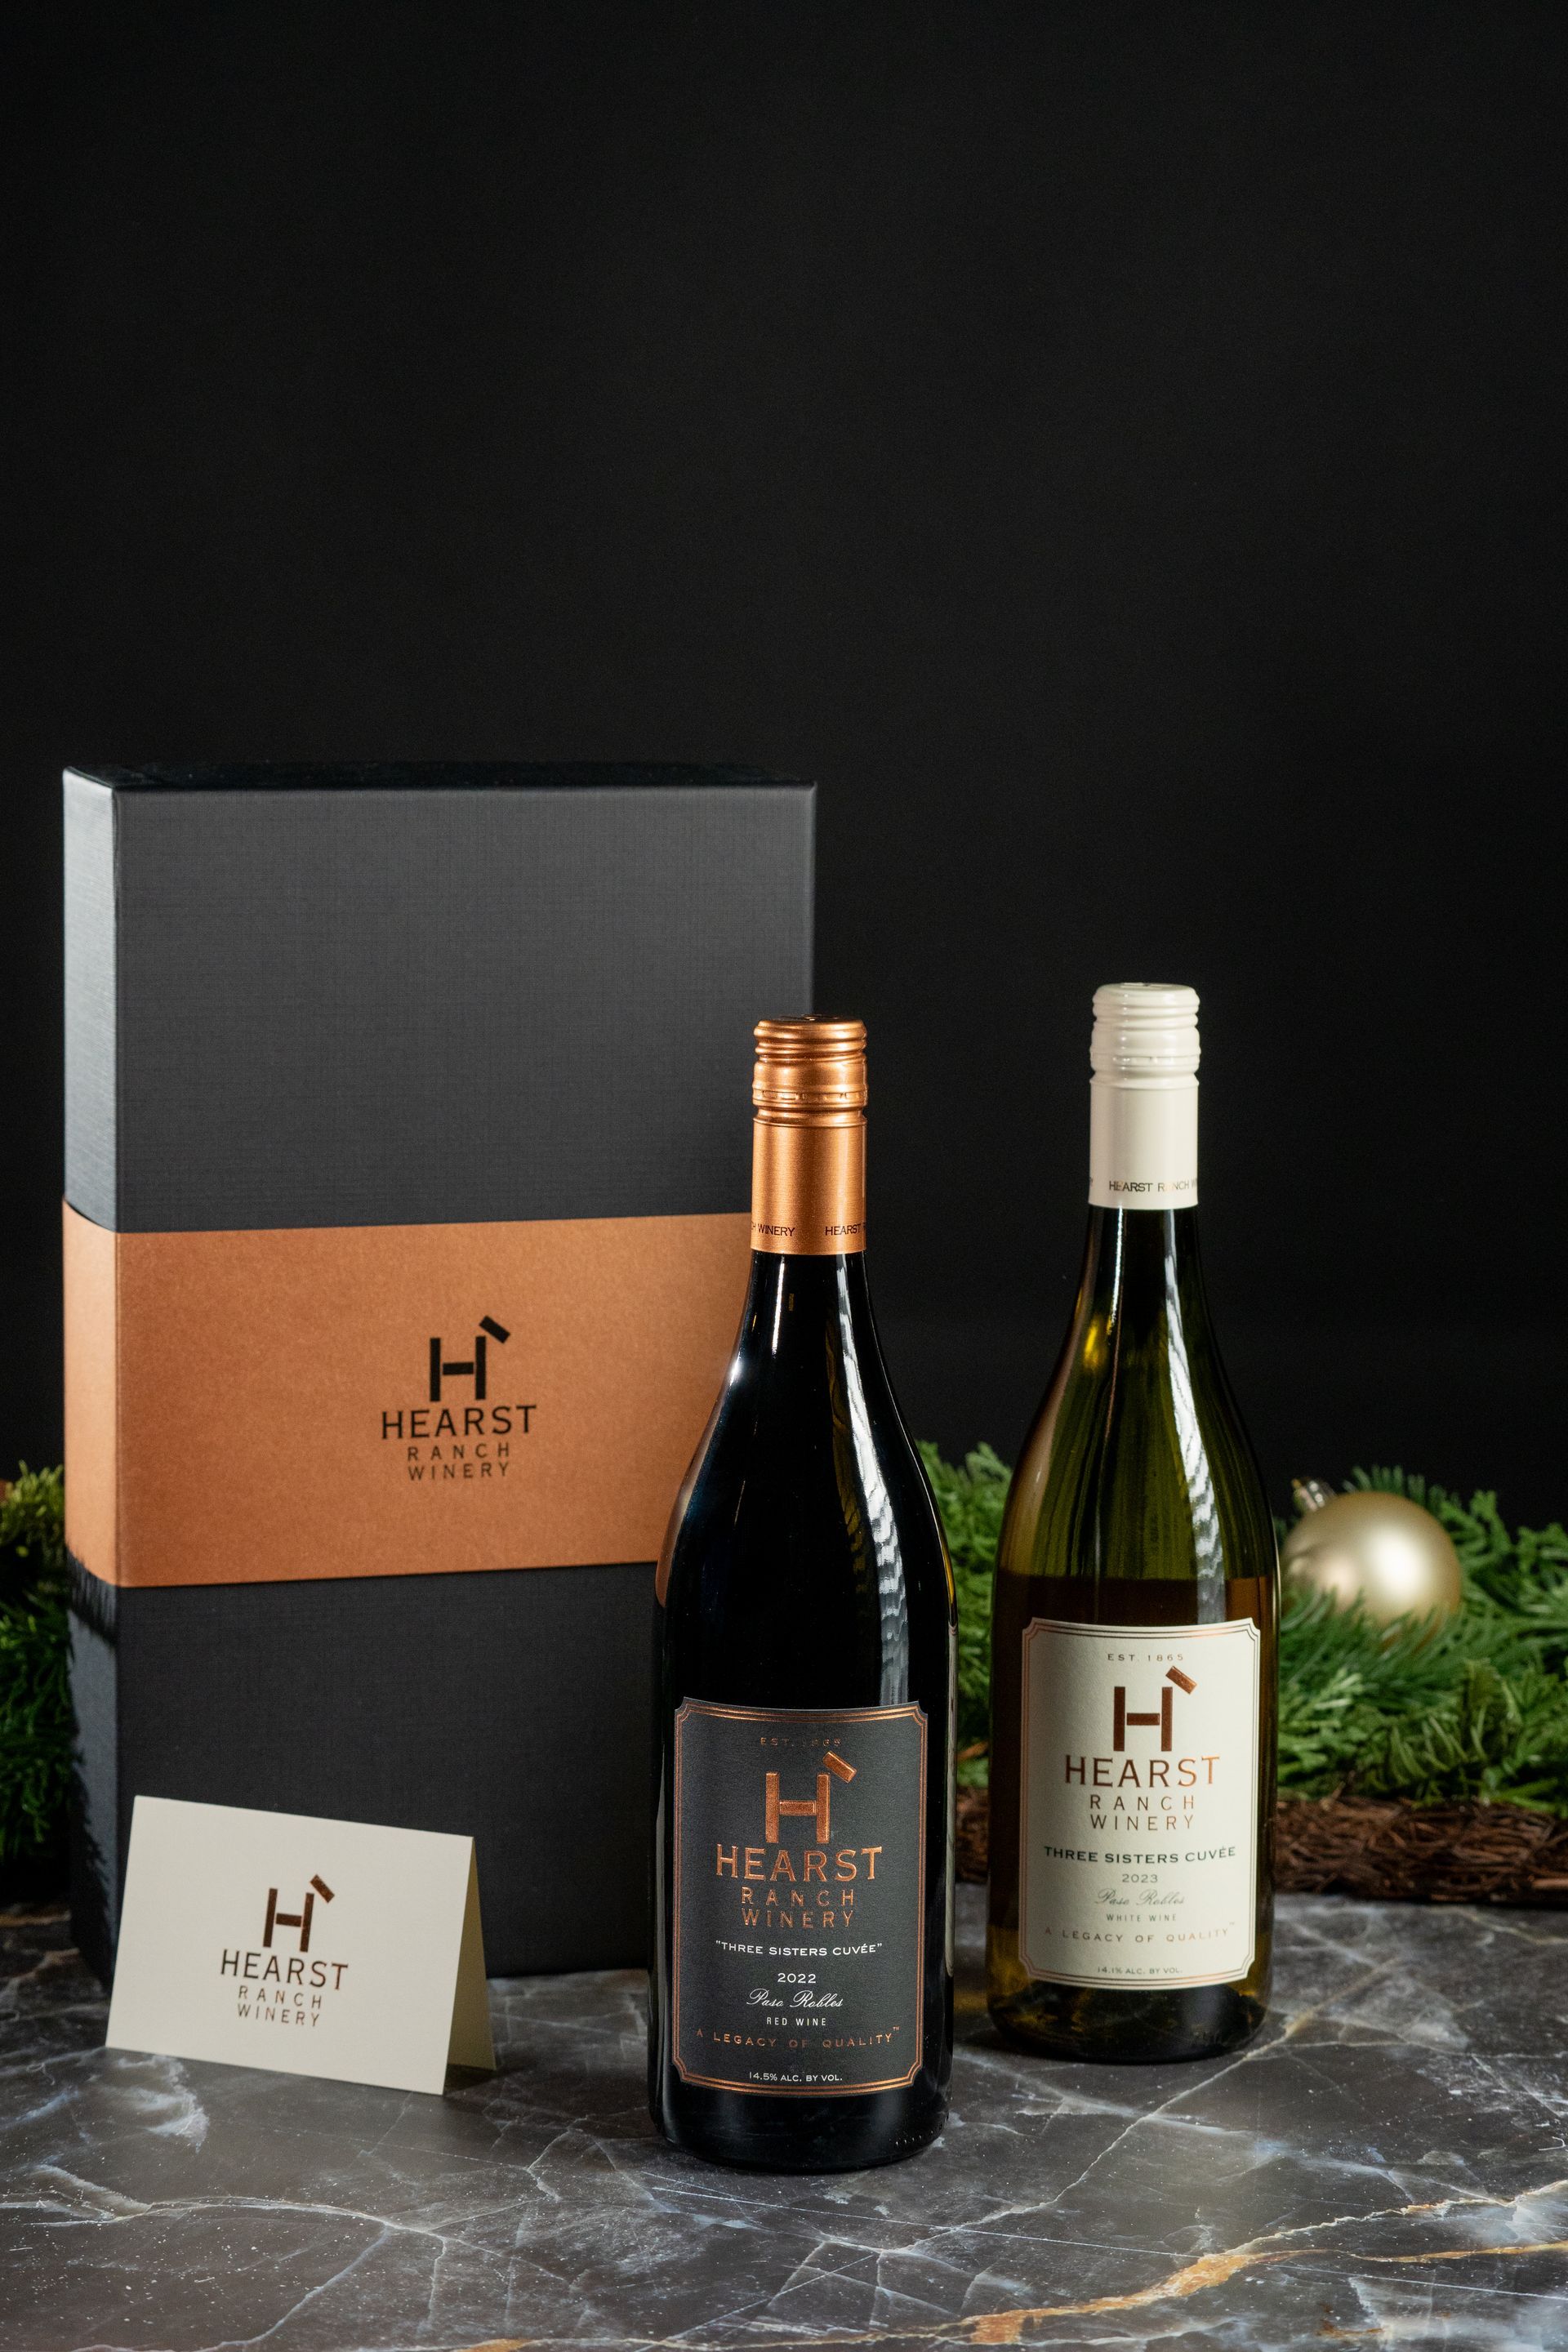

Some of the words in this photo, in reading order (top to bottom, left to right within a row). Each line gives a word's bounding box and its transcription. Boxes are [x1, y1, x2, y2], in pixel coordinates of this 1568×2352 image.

[1109, 1181, 1153, 1192] HEARST
[1158, 1180, 1189, 1192] RNCH
[758, 1223, 795, 1236] WINERY
[825, 1223, 861, 1236] HEARST
[381, 1404, 537, 1439] HEARST
[408, 1442, 509, 1461] RANCH
[408, 1462, 509, 1481] WINERY
[1148, 1654, 1183, 1662] 1865
[1065, 1754, 1220, 1788] HEARST
[1090, 1793, 1194, 1811] RANCH
[1090, 1814, 1194, 1831] WINERY
[716, 1844, 882, 1882] HEARST
[1044, 1846, 1098, 1863] THREE
[1105, 1853, 1178, 1864] SISTERS
[1122, 1873, 1158, 1883] 2023
[741, 1886, 854, 1906] RANCH
[1094, 1887, 1129, 1905] Paso
[1136, 1888, 1185, 1906] Robles
[741, 1908, 853, 1928] WINERY
[1106, 1913, 1142, 1922] WHITE
[1045, 1927, 1052, 1935] A
[1062, 1930, 1123, 1943] LEGACY
[1135, 1935, 1154, 1943] OF
[768, 1946, 827, 1956] SISTERS
[220, 1949, 349, 1990] HEARST
[777, 1972, 816, 1984] 2022
[238, 1985, 322, 2010] RANCH
[746, 1988, 784, 2007] Paso
[790, 1989, 843, 2008] Robles
[238, 2003, 319, 2027] WINERY
[766, 2016, 787, 2025] RED
[795, 2017, 826, 2026] WINE
[696, 2029, 703, 2038] A
[714, 2031, 777, 2047] LEGACY
[789, 2039, 808, 2048] OF
[749, 2072, 777, 2082] 14.5%
[781, 2074, 802, 2082] ALC.
[821, 2074, 843, 2082] VOL.
